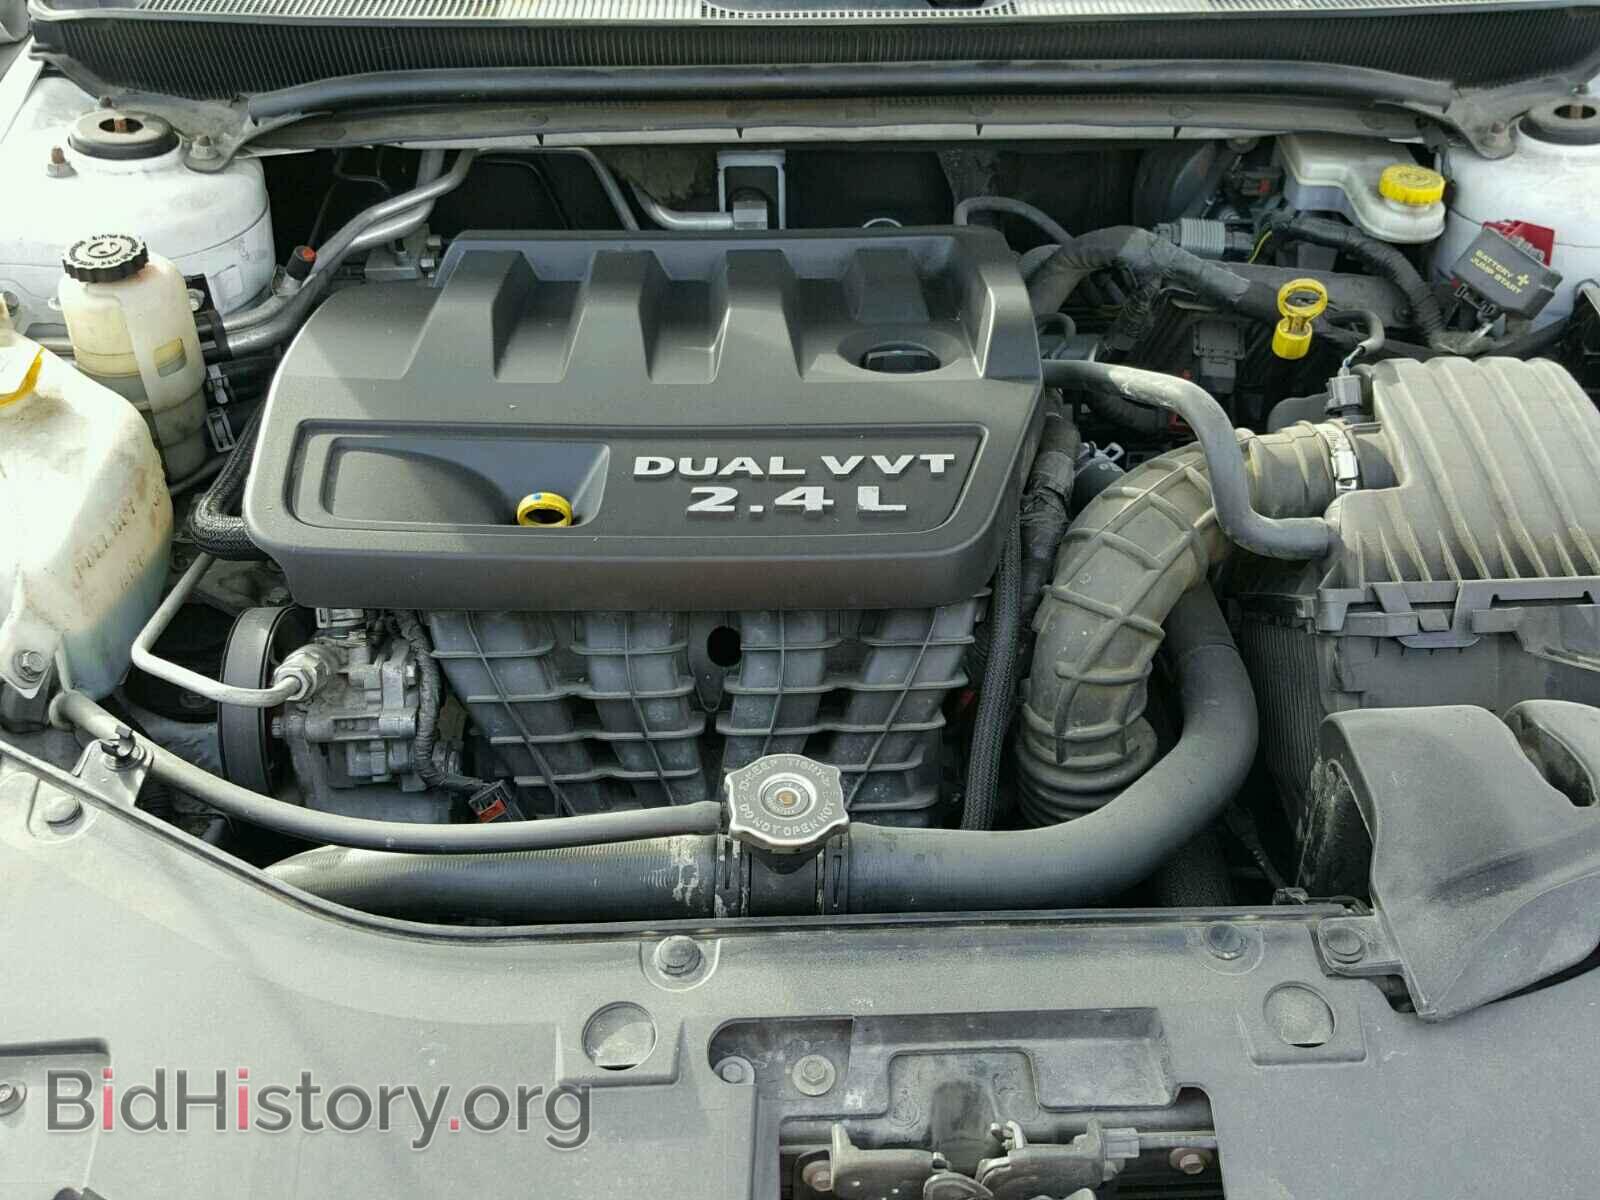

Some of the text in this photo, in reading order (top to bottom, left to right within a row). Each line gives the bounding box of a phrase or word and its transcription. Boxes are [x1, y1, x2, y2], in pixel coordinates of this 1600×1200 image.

[1475, 249, 1513, 278] BATTERY
[1494, 273, 1522, 295] START
[633, 454, 955, 479] DUAL VVT
[687, 486, 907, 515] 2.4 L
[740, 801, 836, 837] DO NOT OPEN HOT
